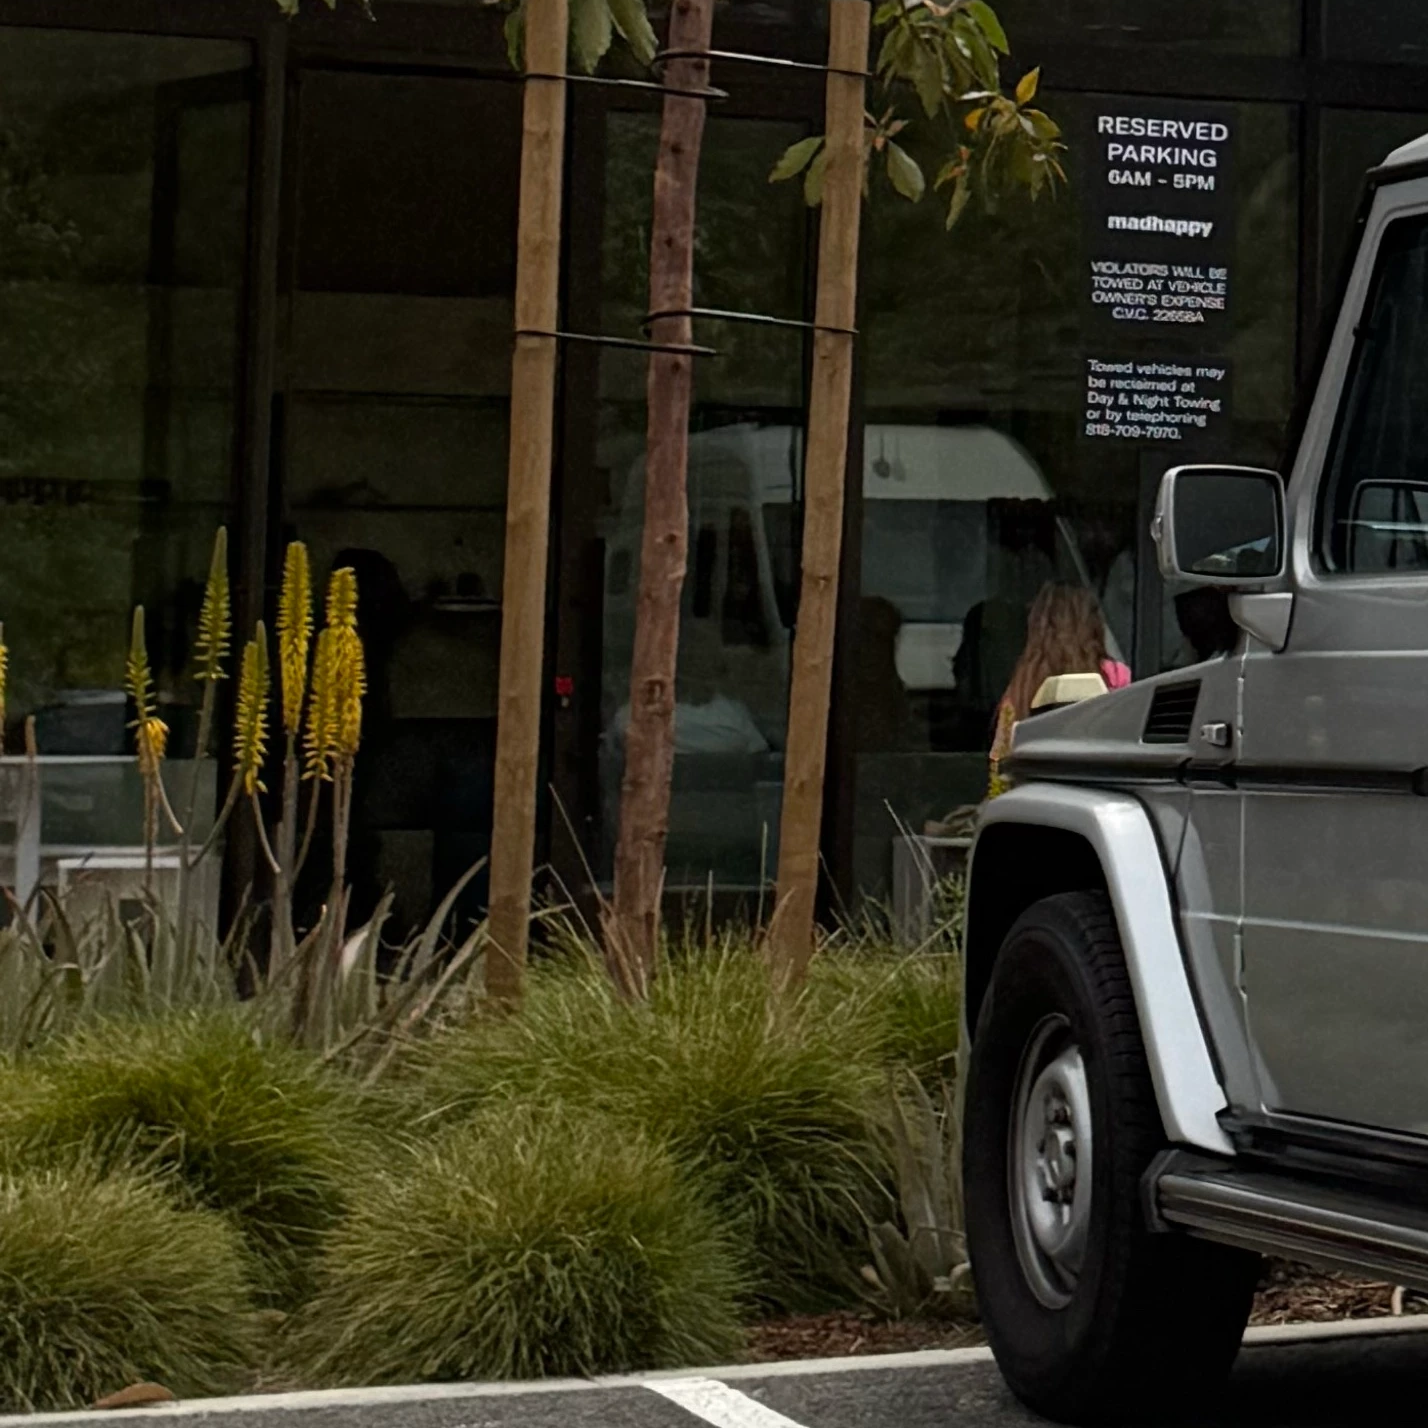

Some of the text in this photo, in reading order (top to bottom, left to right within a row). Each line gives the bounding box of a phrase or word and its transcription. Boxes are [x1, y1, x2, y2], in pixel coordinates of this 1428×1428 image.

[1097, 115, 1229, 142] RESERVED
[1107, 143, 1217, 168] PARKING
[1108, 169, 1151, 187] 6AM
[1173, 174, 1215, 190] 5PM
[1108, 215, 1213, 238] madhappy
[1090, 261, 1227, 280] VIOLATORS WILL BE
[1092, 276, 1226, 294] TOWED AT VEHICLE
[1091, 290, 1225, 309] OWNER'S EXPENSE
[1087, 359, 1225, 380] Towed vehicles may
[1088, 375, 1196, 393] be reclaimed at
[1087, 391, 1221, 412] Day & Night Towing
[1086, 409, 1207, 427] or by telephoning
